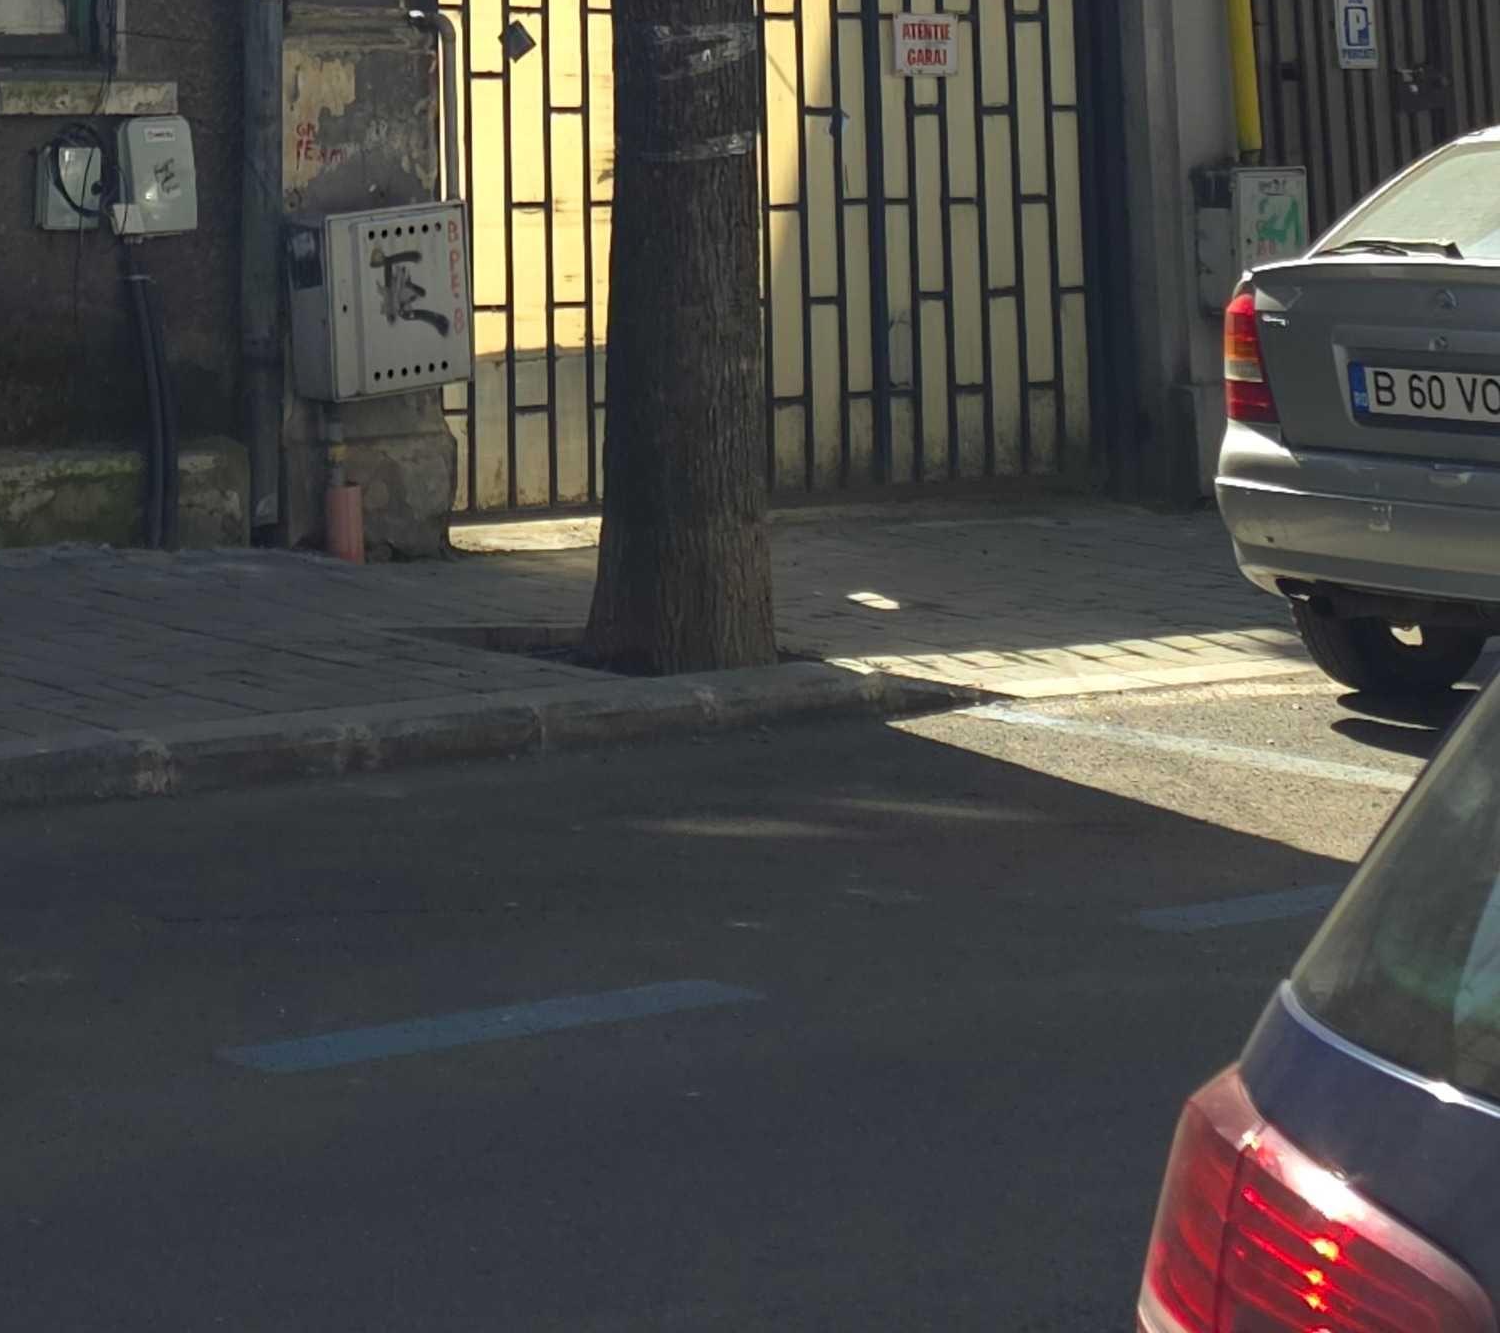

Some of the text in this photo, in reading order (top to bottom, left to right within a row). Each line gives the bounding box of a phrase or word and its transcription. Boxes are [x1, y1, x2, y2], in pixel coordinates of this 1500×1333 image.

[1348, 9, 1366, 43] P
[907, 48, 947, 66] GARAJ
[1374, 371, 1396, 406] B
[1408, 374, 1445, 410] 60
